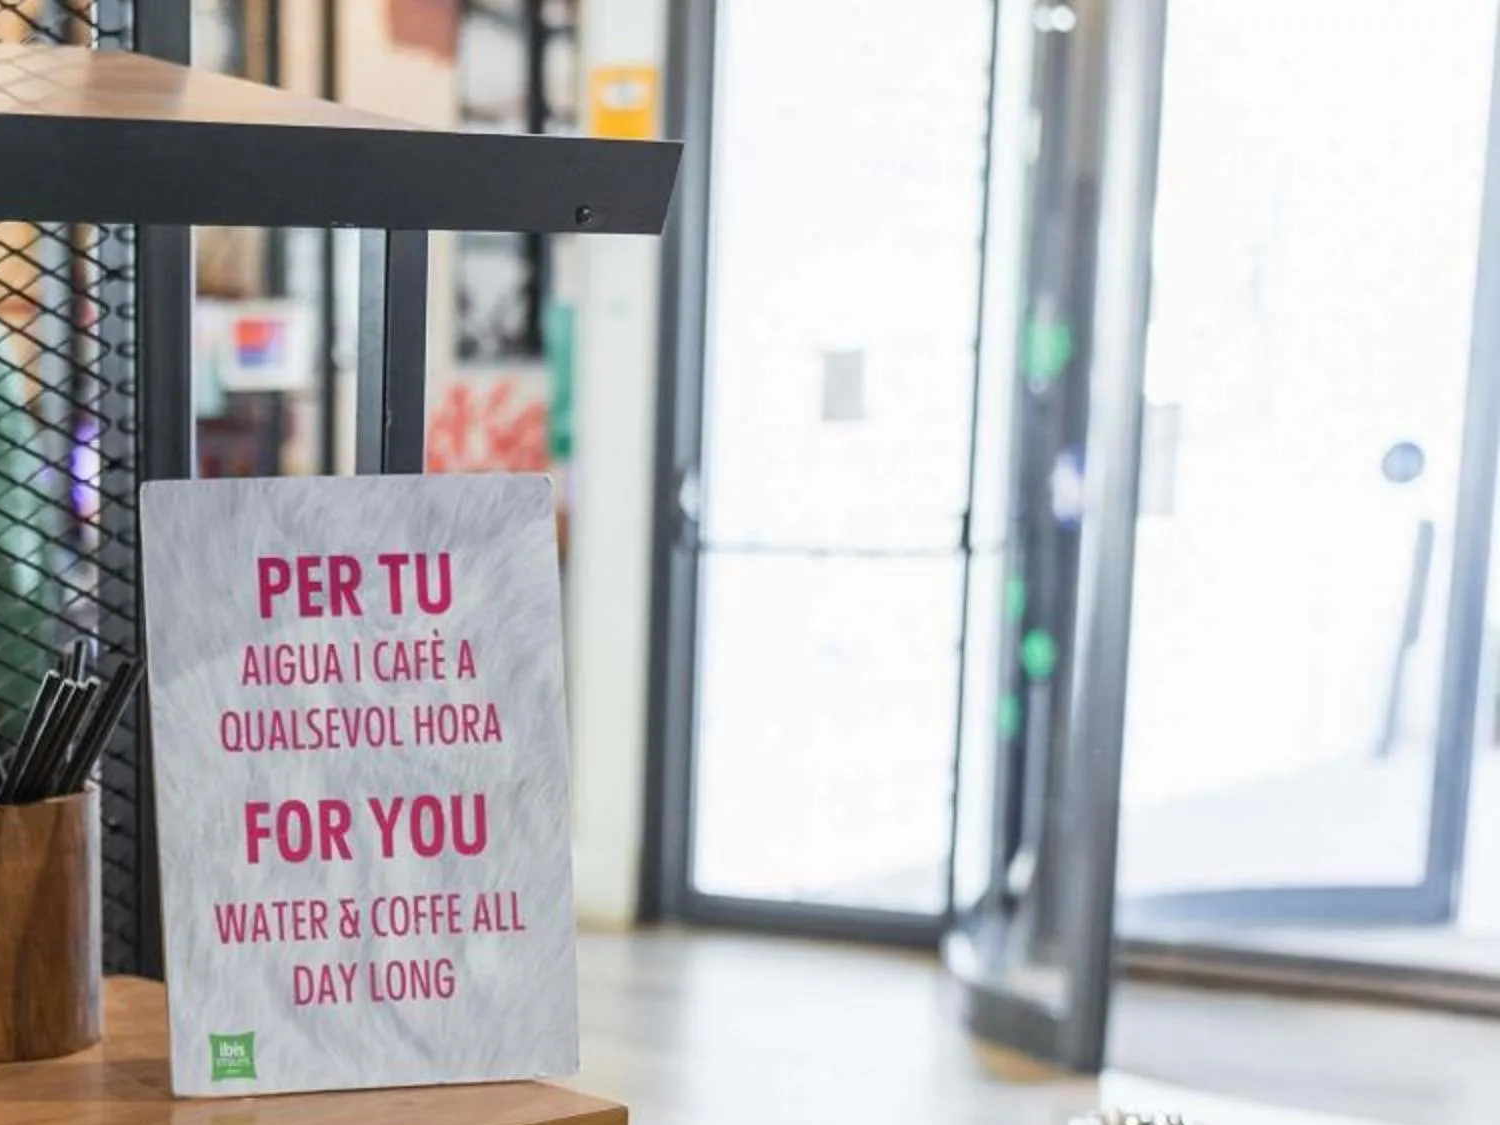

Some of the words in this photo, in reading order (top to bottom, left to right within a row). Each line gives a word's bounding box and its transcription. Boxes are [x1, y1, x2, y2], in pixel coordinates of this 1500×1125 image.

[256, 554, 363, 620] PER
[376, 550, 454, 617] TU
[241, 643, 342, 686] AIGUA
[353, 643, 362, 683] I
[372, 630, 445, 682] CAFÈ
[456, 638, 478, 680] A
[220, 705, 404, 753] QUALSEVOL
[414, 702, 502, 747] HORA
[243, 799, 353, 865] FOR
[367, 792, 489, 860] YOU
[214, 899, 329, 945] WATER
[339, 897, 362, 939] &
[370, 893, 463, 938] COFFE
[472, 890, 527, 932] ALL
[292, 962, 358, 1006] DAY
[368, 957, 457, 1003] LONG
